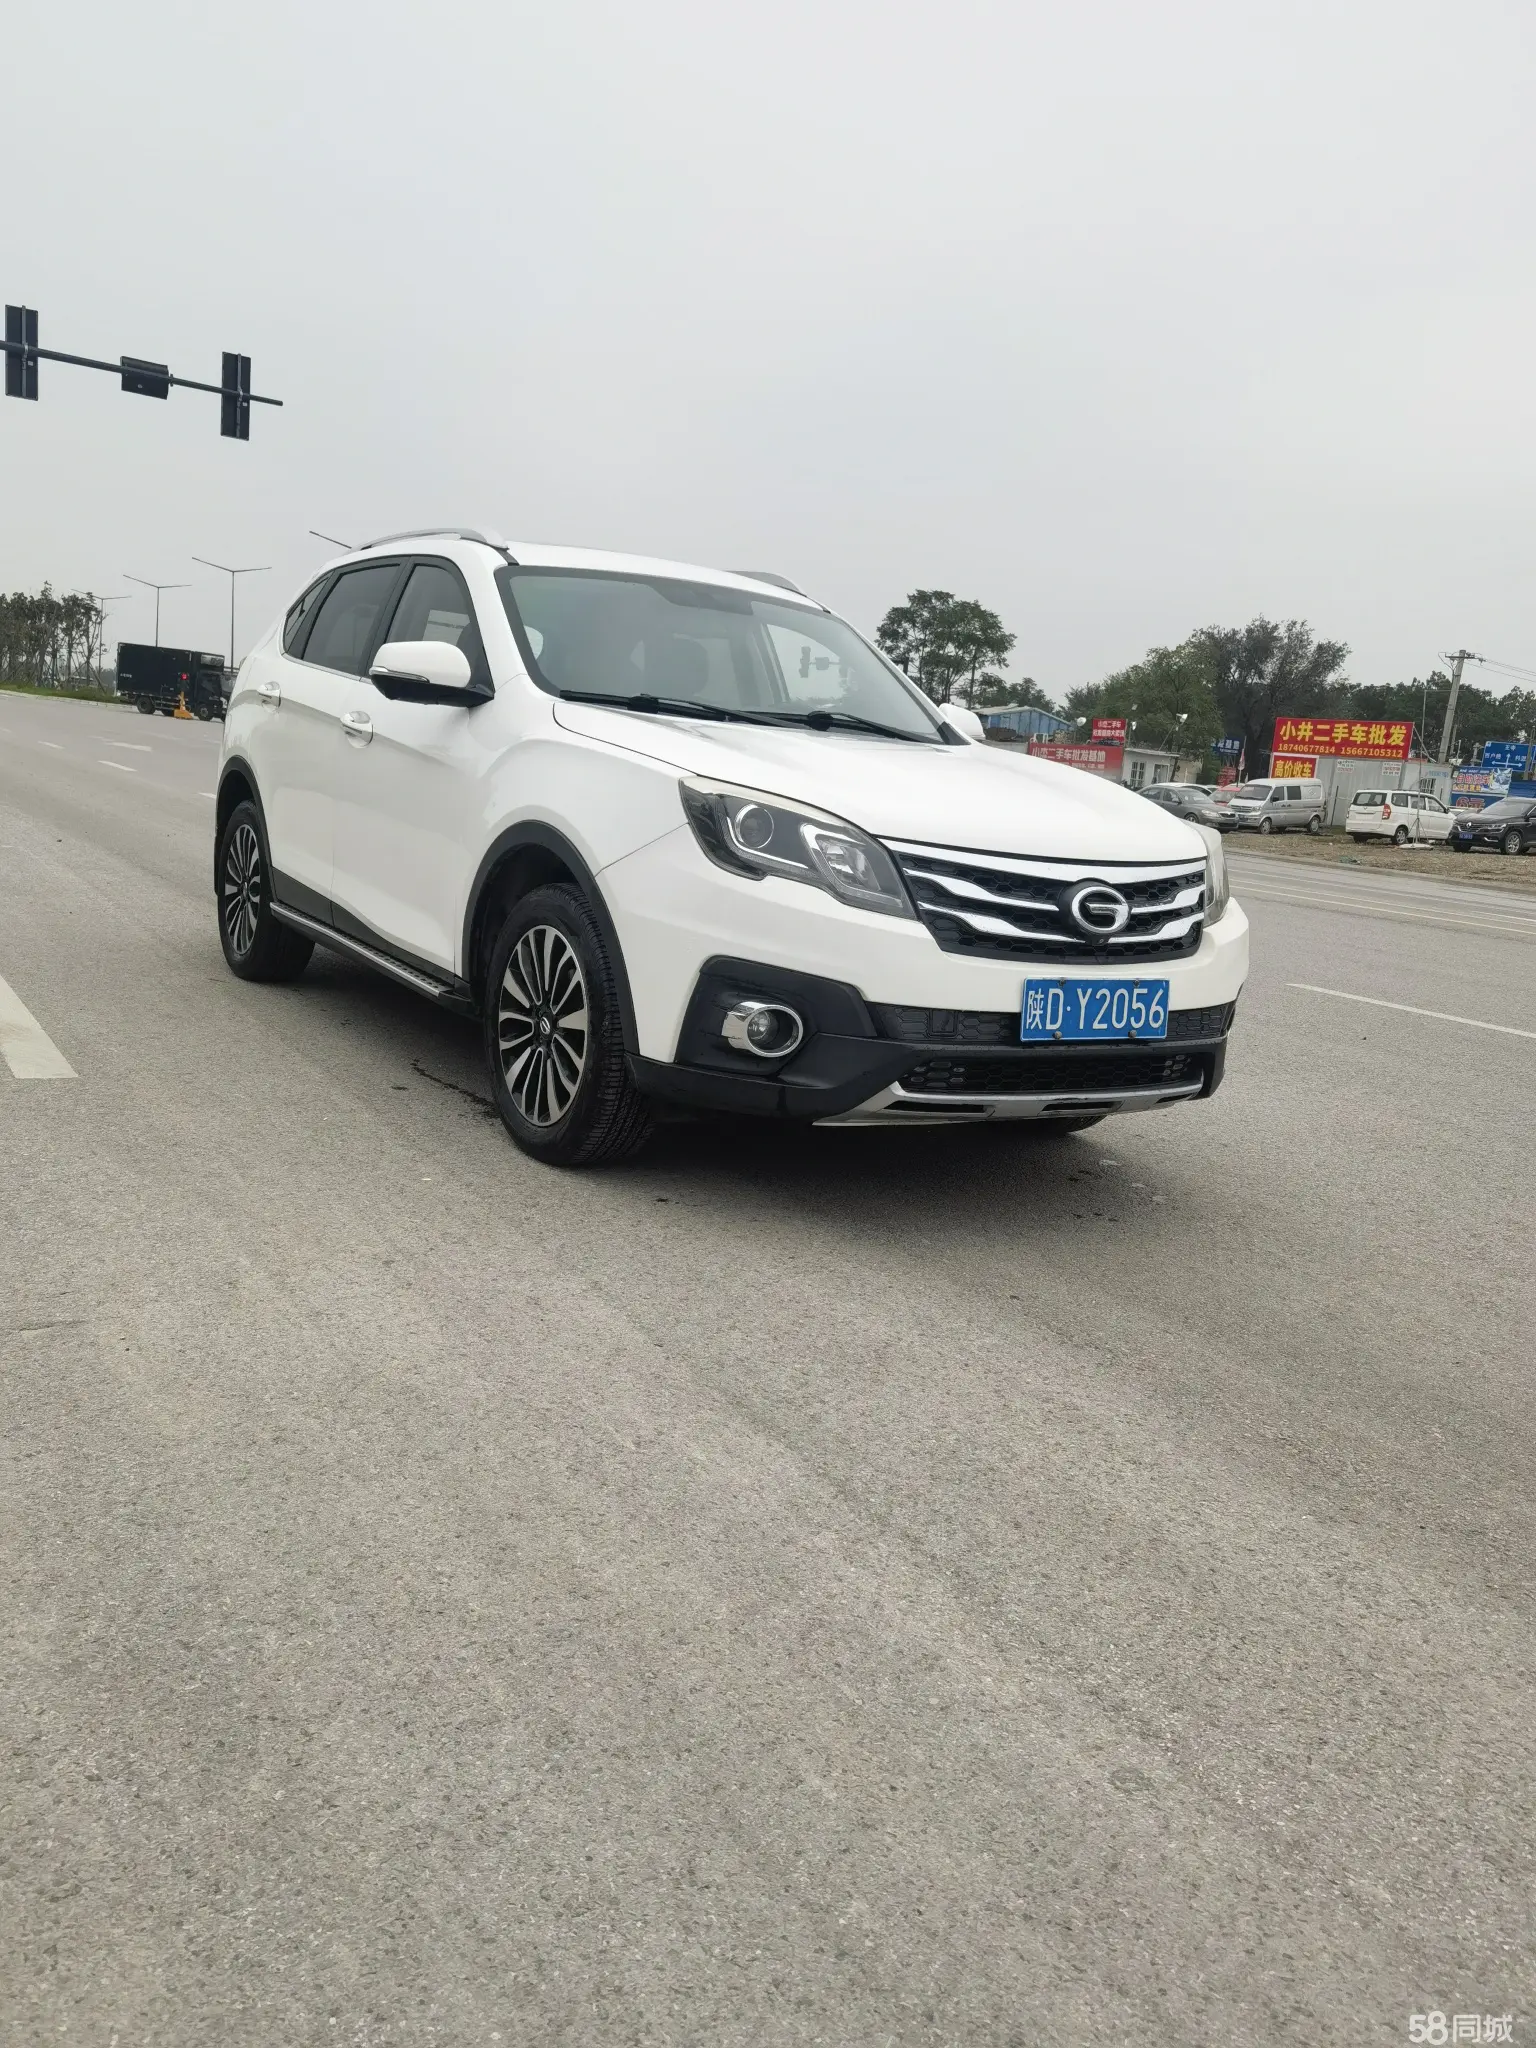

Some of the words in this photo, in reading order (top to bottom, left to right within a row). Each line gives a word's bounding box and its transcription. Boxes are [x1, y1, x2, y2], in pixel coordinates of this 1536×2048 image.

[1279, 720, 1407, 747] 小井二手车批发
[1277, 743, 1336, 754] 18740677814
[1340, 746, 1404, 758] 15667105312
[1274, 759, 1313, 778] 高价收车
[1025, 987, 1165, 1031] 陕D·Y2056
